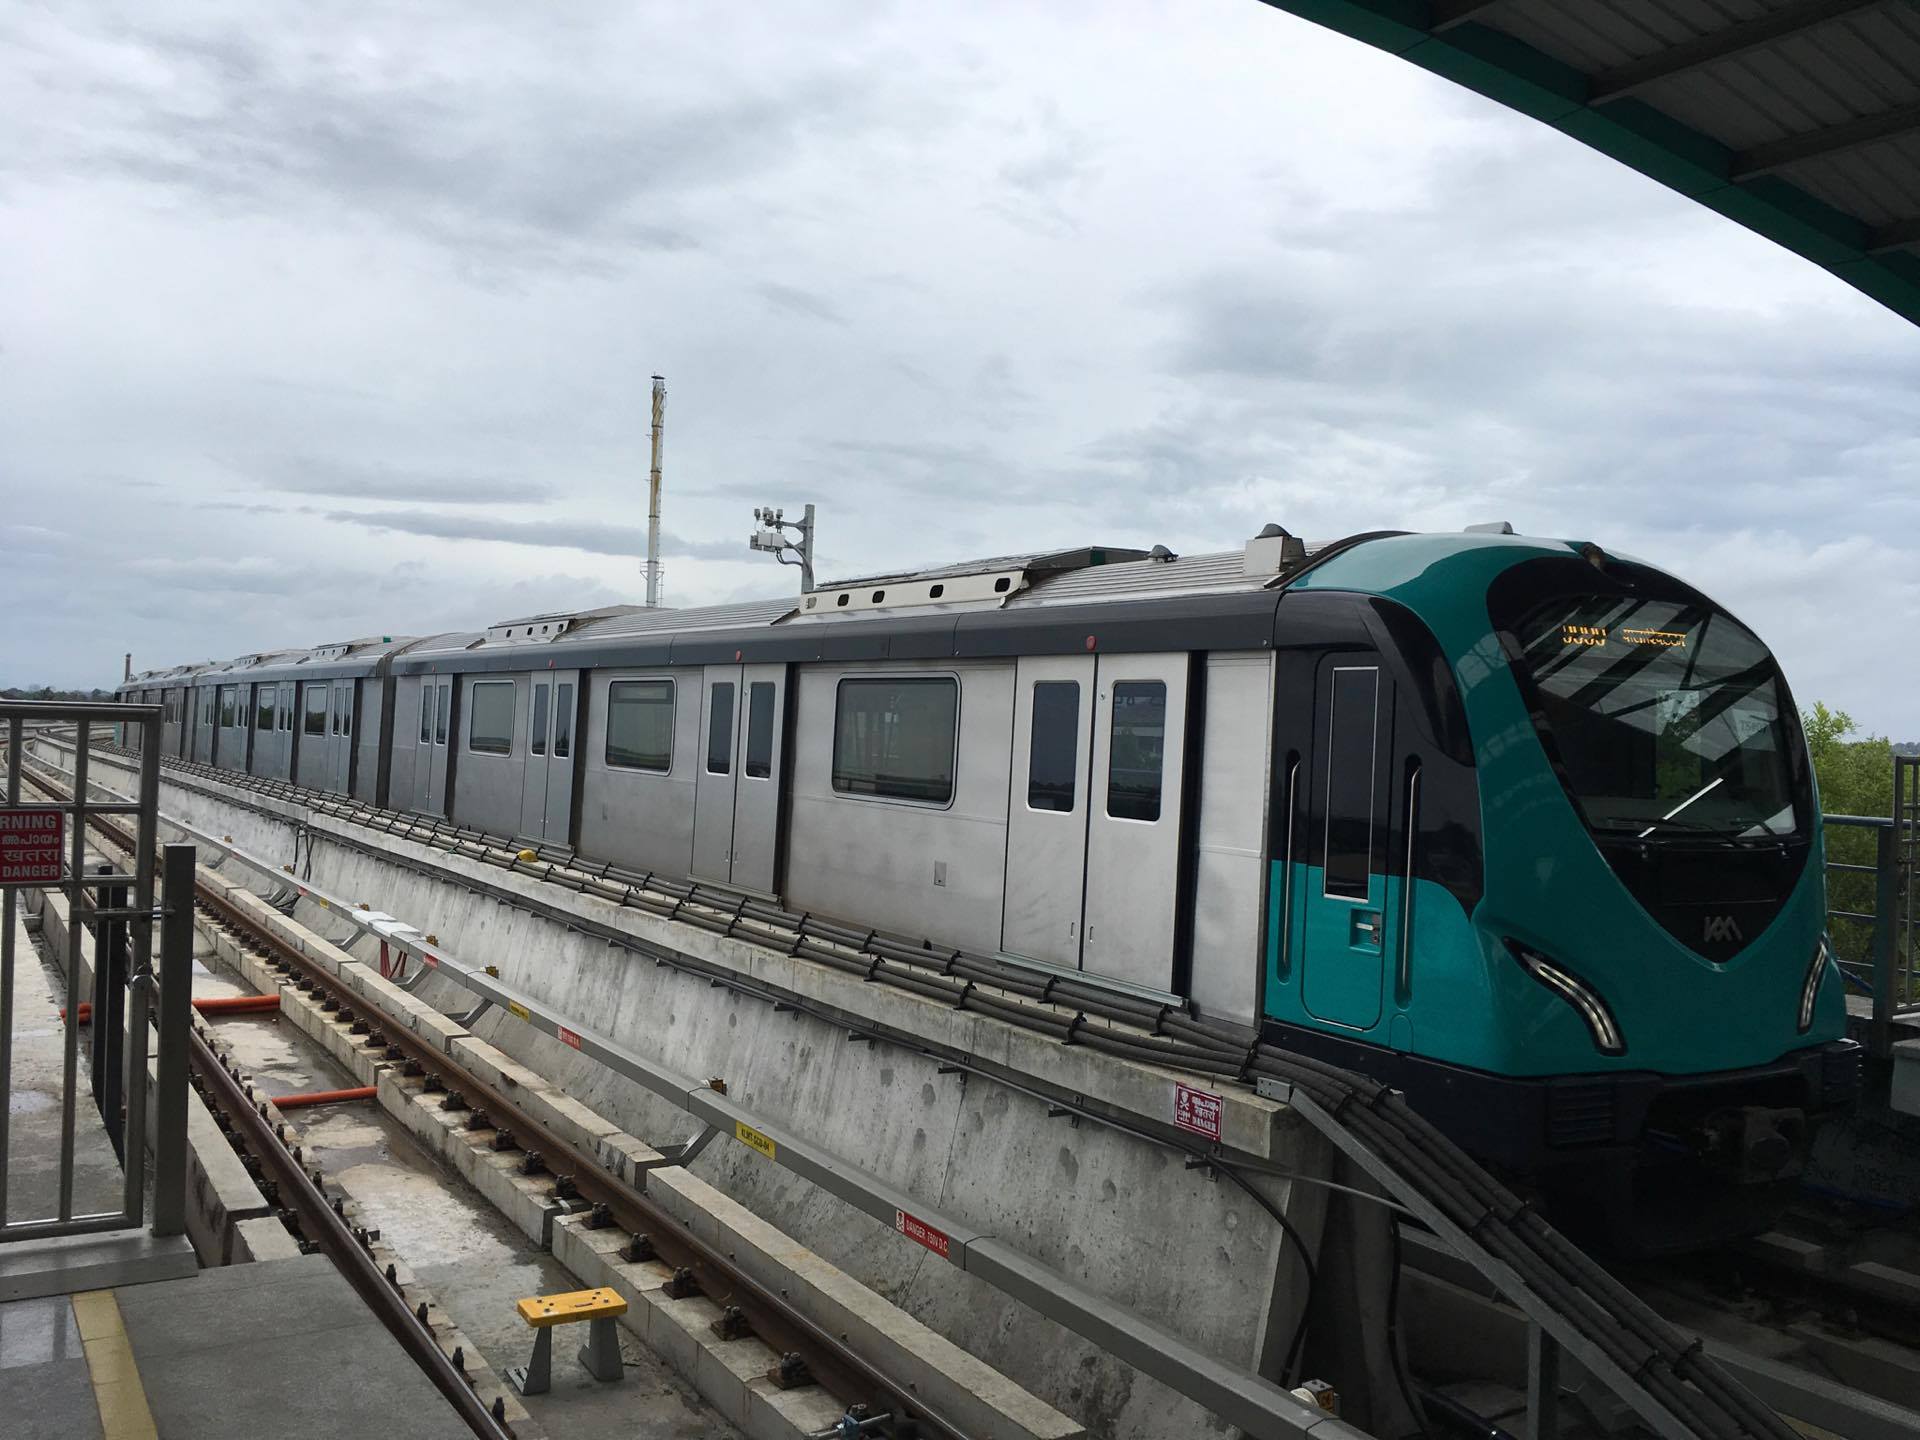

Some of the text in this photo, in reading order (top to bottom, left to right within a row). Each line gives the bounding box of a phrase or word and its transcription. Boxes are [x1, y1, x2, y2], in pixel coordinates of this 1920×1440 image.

[2, 849, 60, 862] खतरा
[2, 864, 58, 878] DANGER
[1193, 1116, 1217, 1133] DANGER
[906, 1219, 926, 1239] DANGER
